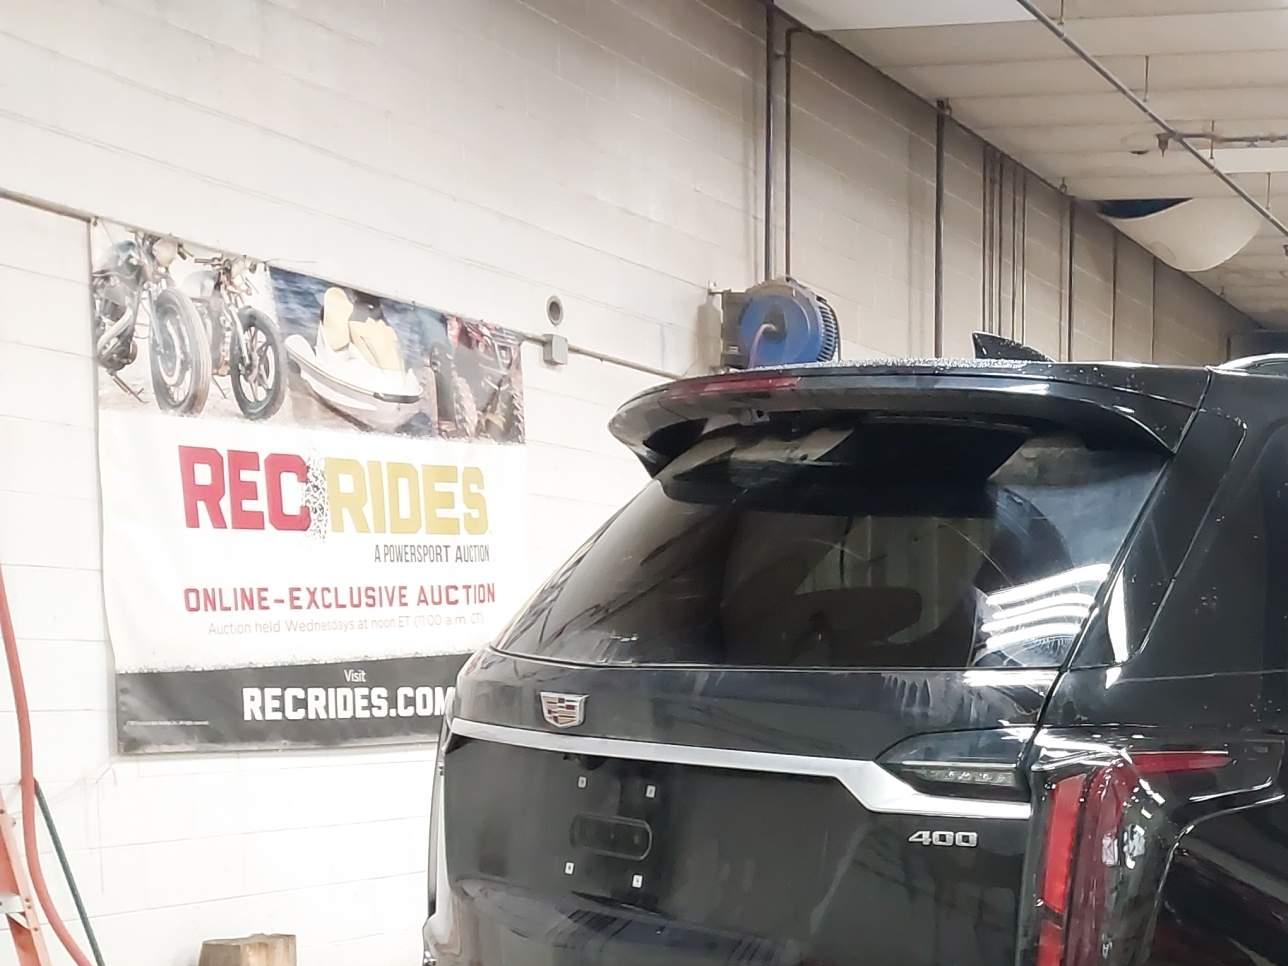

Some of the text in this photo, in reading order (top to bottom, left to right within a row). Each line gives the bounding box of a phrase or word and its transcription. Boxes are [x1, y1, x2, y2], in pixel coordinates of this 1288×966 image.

[374, 544, 490, 563] A POWERSPORT AUCTION
[183, 583, 496, 612] ONLINE-EXCLUSIVE AUCTION
[208, 621, 251, 635] Auction
[255, 618, 281, 633] held
[285, 617, 355, 633] Wednesdays
[357, 616, 369, 630] at
[398, 615, 412, 628] ET
[343, 669, 367, 683] Visit
[908, 830, 978, 847] 400
